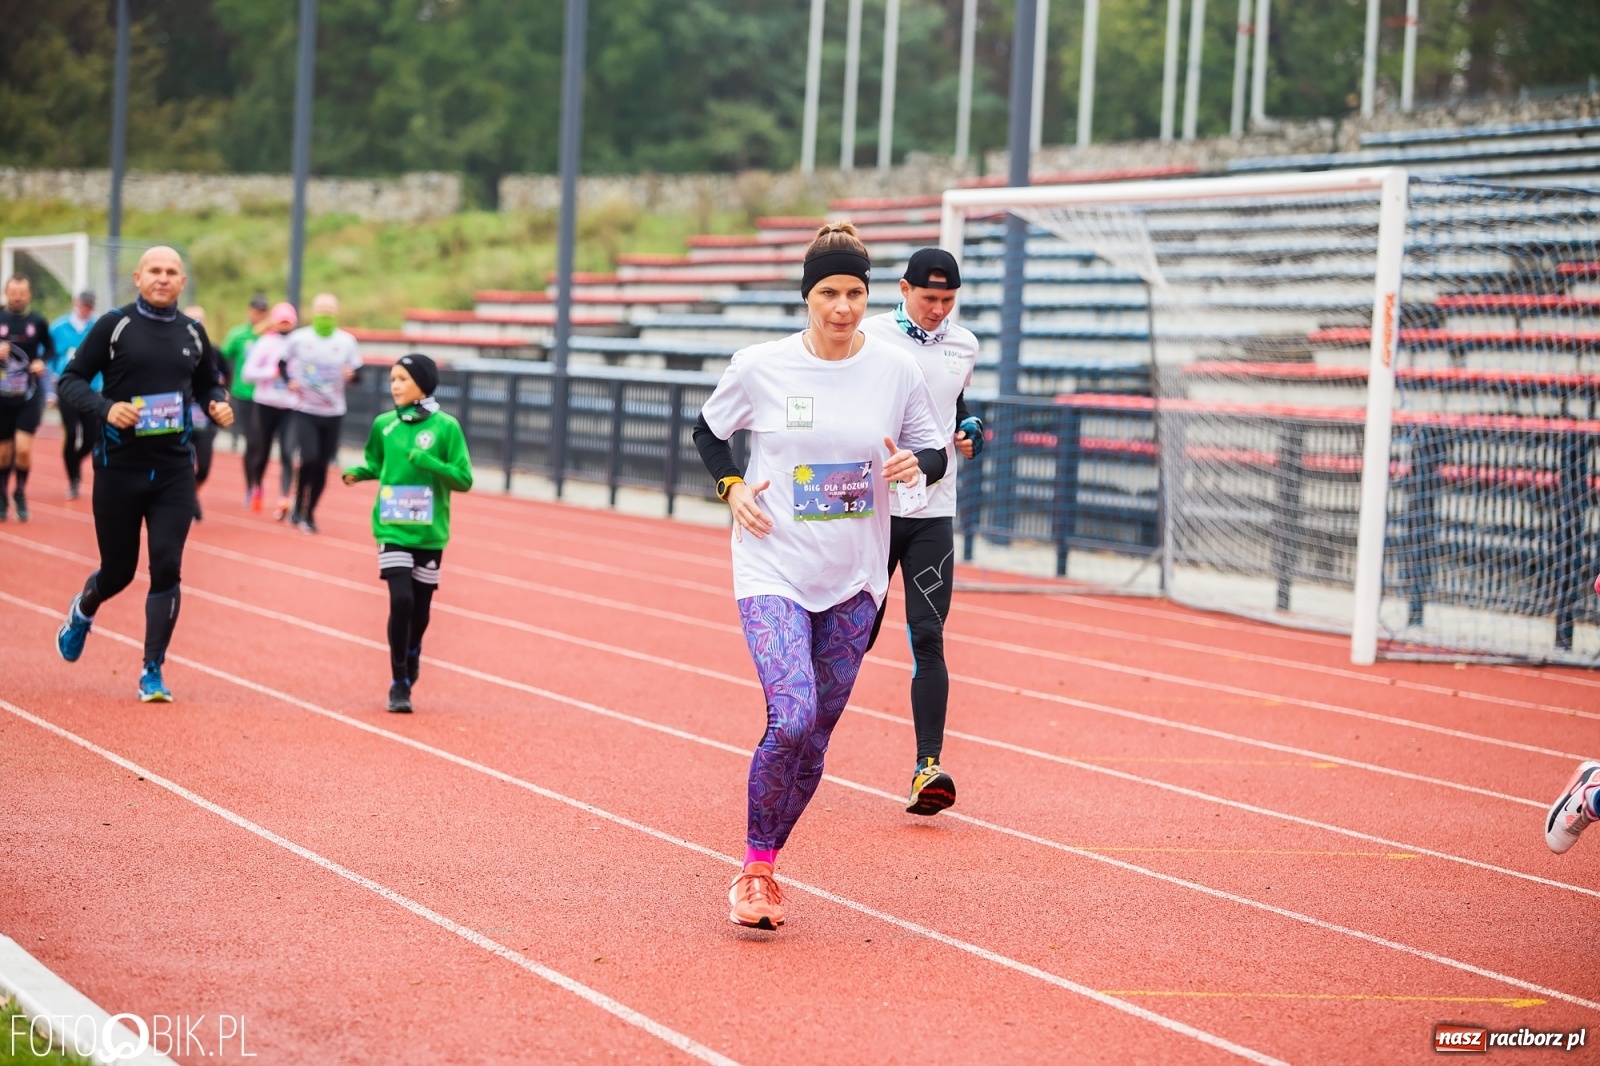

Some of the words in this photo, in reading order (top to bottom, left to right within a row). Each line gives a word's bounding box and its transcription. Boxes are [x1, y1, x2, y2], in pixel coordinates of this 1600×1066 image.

[803, 484, 821, 492] BIEG
[824, 484, 838, 492] DLA
[843, 500, 867, 513] 129
